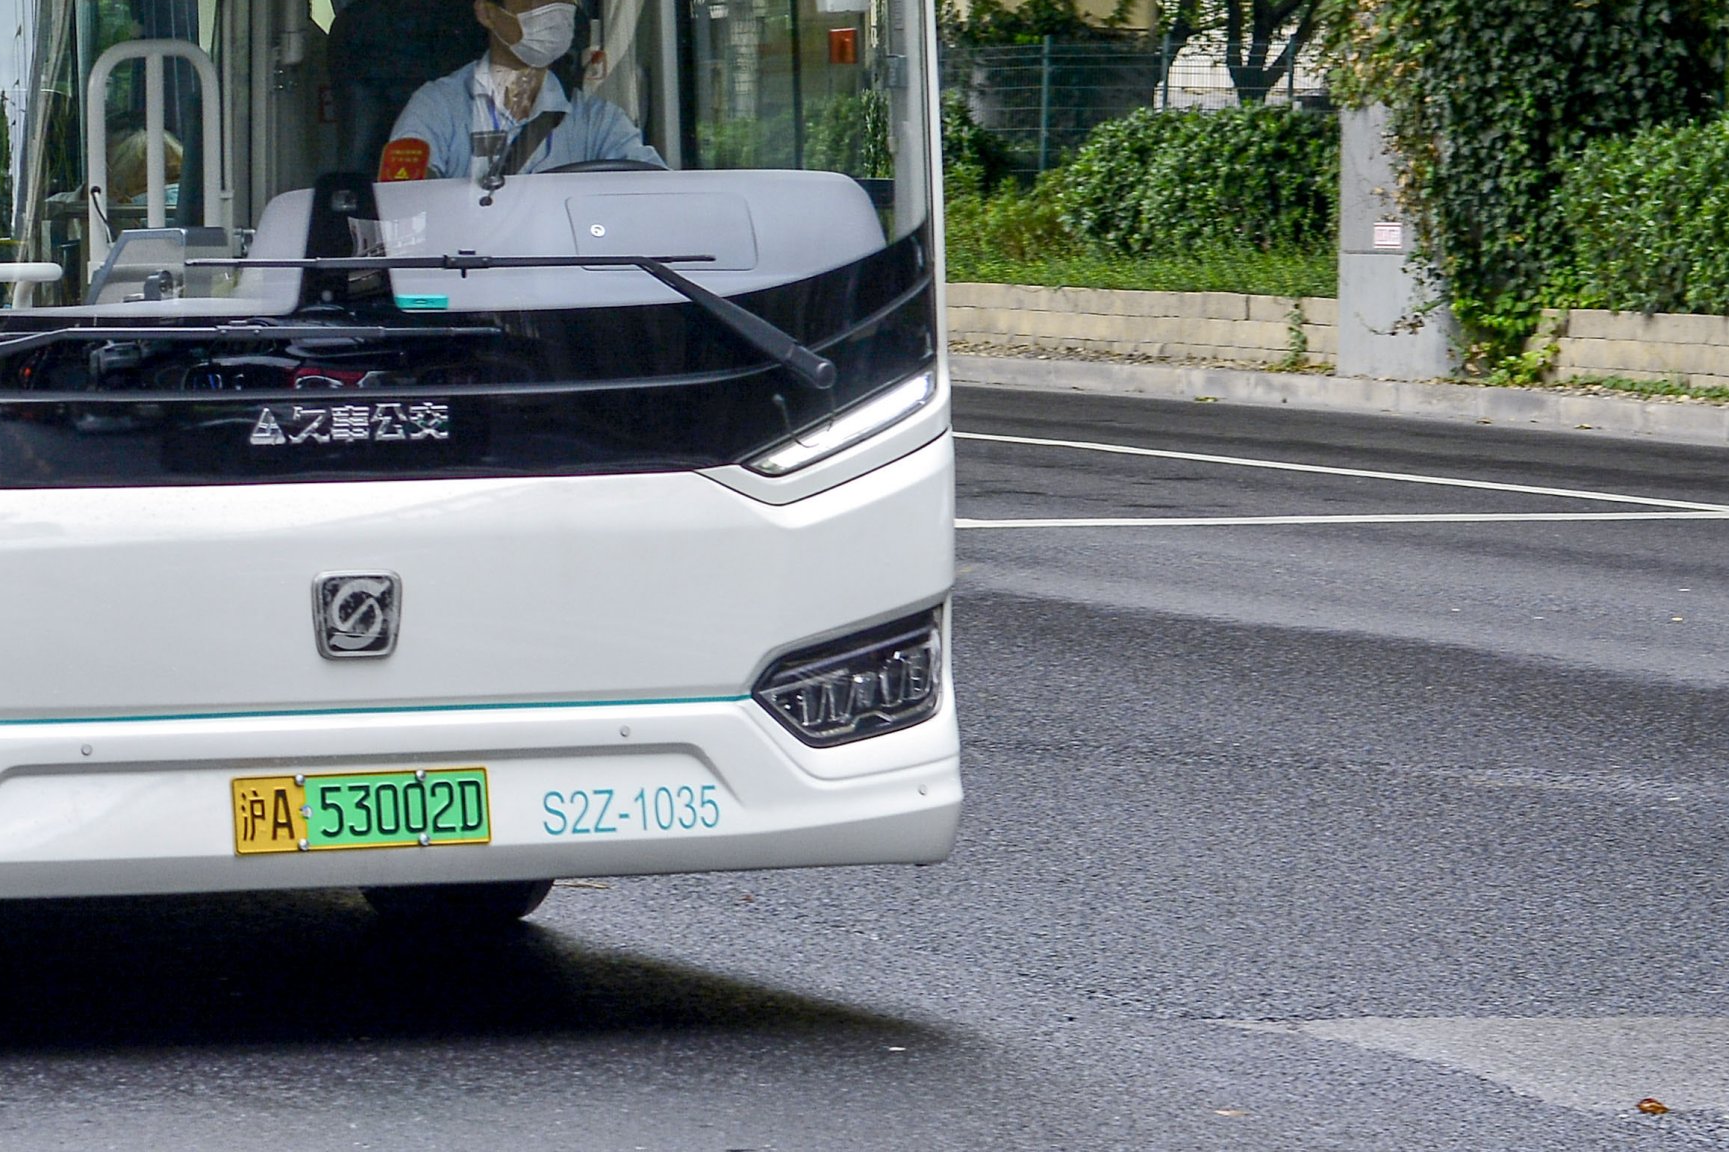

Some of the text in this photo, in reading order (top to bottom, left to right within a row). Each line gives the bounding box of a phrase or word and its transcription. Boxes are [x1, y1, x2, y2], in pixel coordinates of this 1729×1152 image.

[240, 778, 483, 842] 沪A 53002D
[542, 785, 720, 836] S2Z-1035
